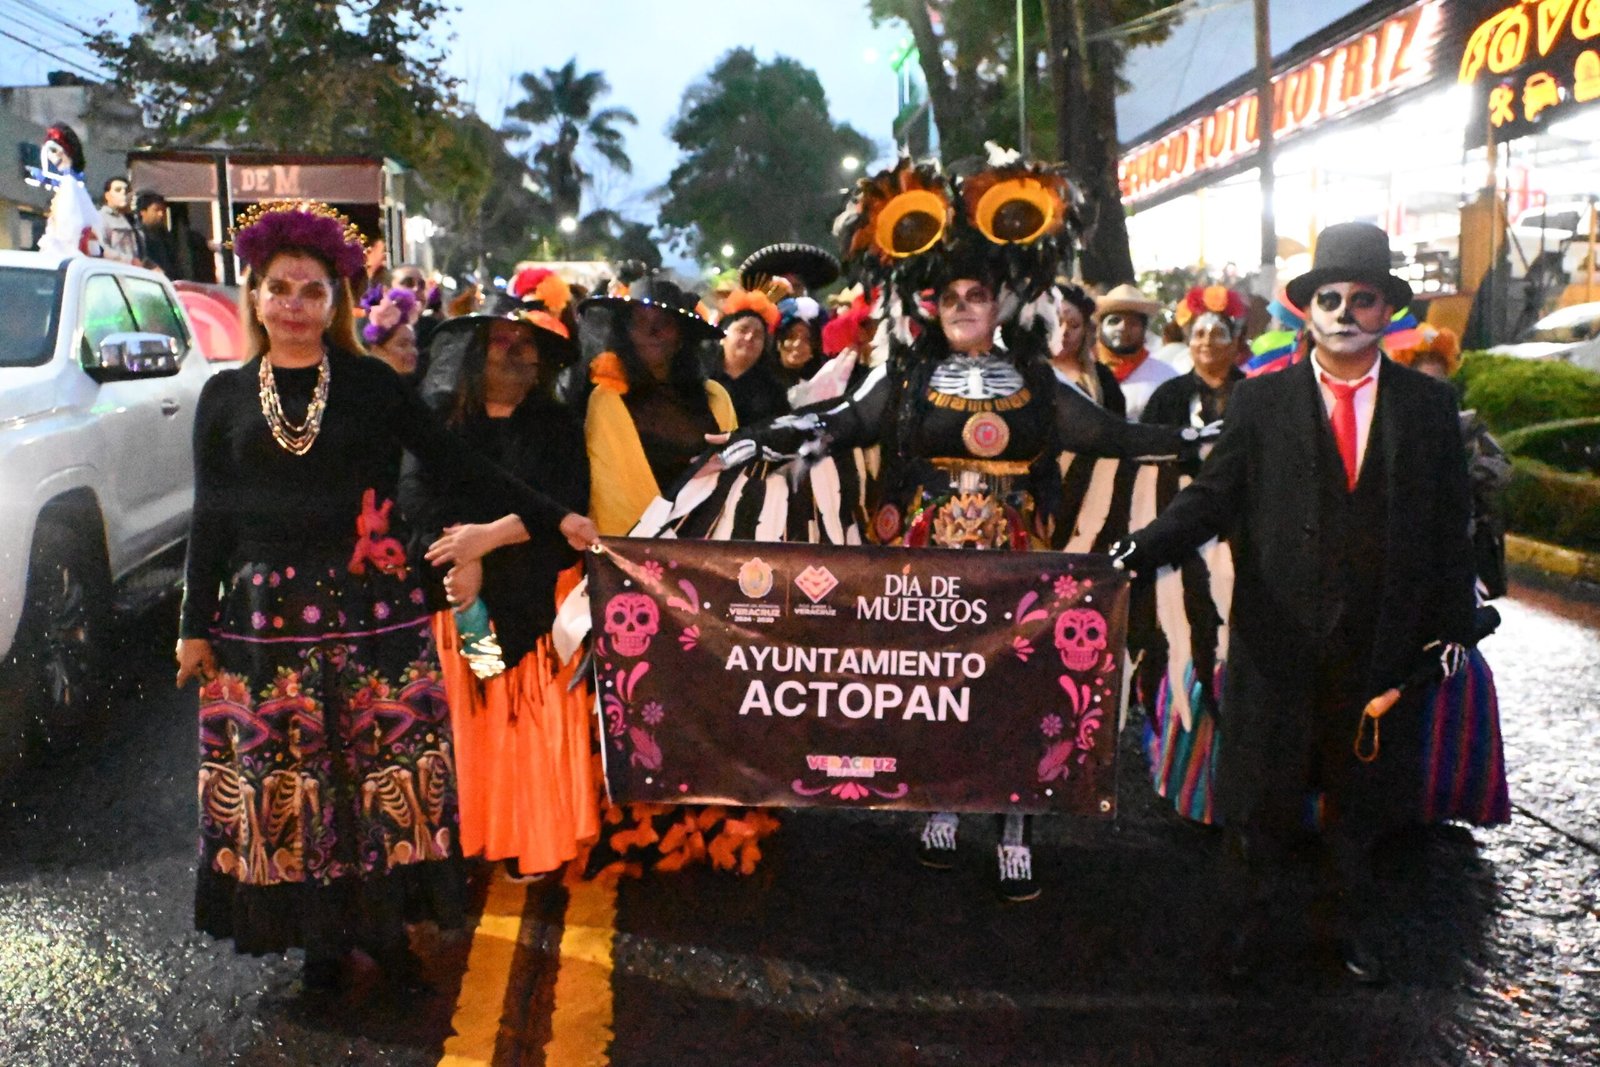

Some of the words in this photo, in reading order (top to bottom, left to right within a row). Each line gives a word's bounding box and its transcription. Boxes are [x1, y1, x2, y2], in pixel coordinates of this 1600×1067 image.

[241, 168, 270, 191] DE
[931, 576, 961, 598] DE
[729, 607, 780, 617] VERACRUZ
[794, 608, 837, 616] VERACRUZ
[857, 596, 988, 632] MUERTOS
[725, 645, 986, 679] AYUNTAMIENTO
[739, 680, 970, 722] ACTOPAN
[806, 755, 897, 772] VERACRUZ
